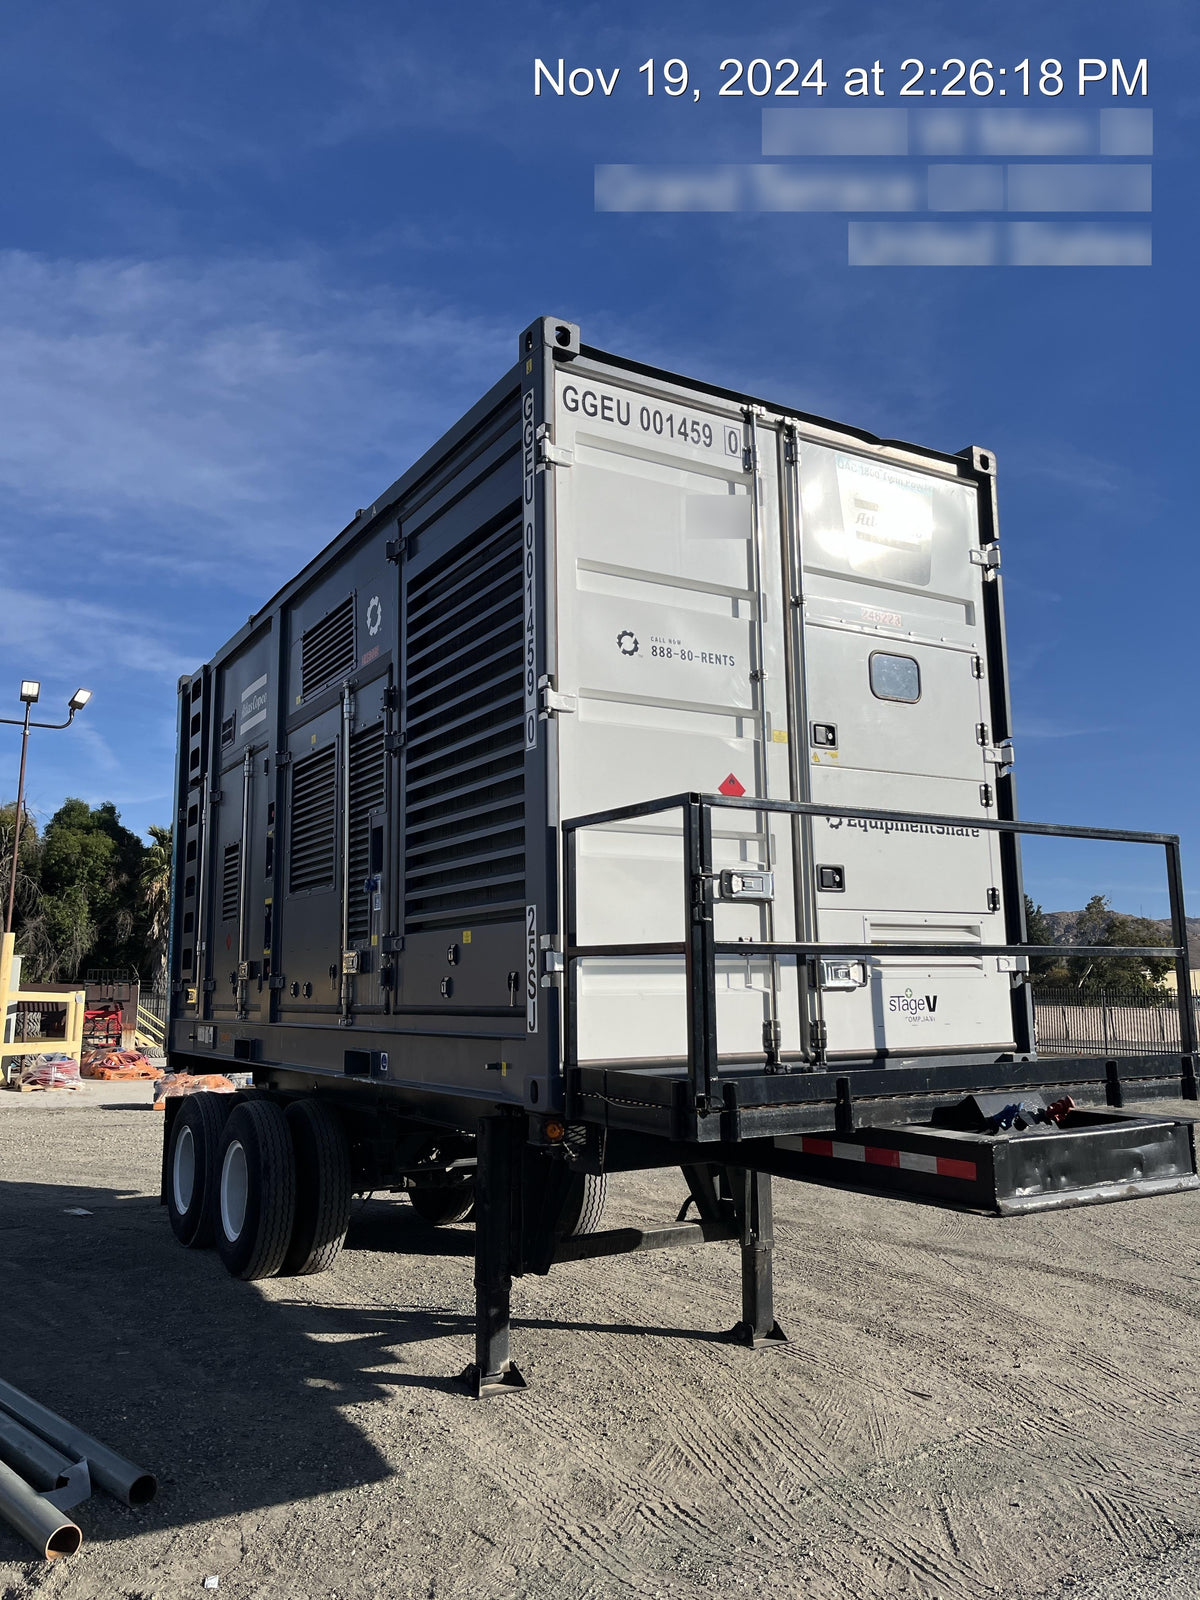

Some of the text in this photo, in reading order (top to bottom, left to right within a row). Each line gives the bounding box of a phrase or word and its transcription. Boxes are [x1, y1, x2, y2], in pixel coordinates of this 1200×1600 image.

[562, 385, 738, 454] GGEU 001459 0
[523, 392, 535, 743] GGEU 001459 0
[651, 645, 735, 667] 888-80-RENTS
